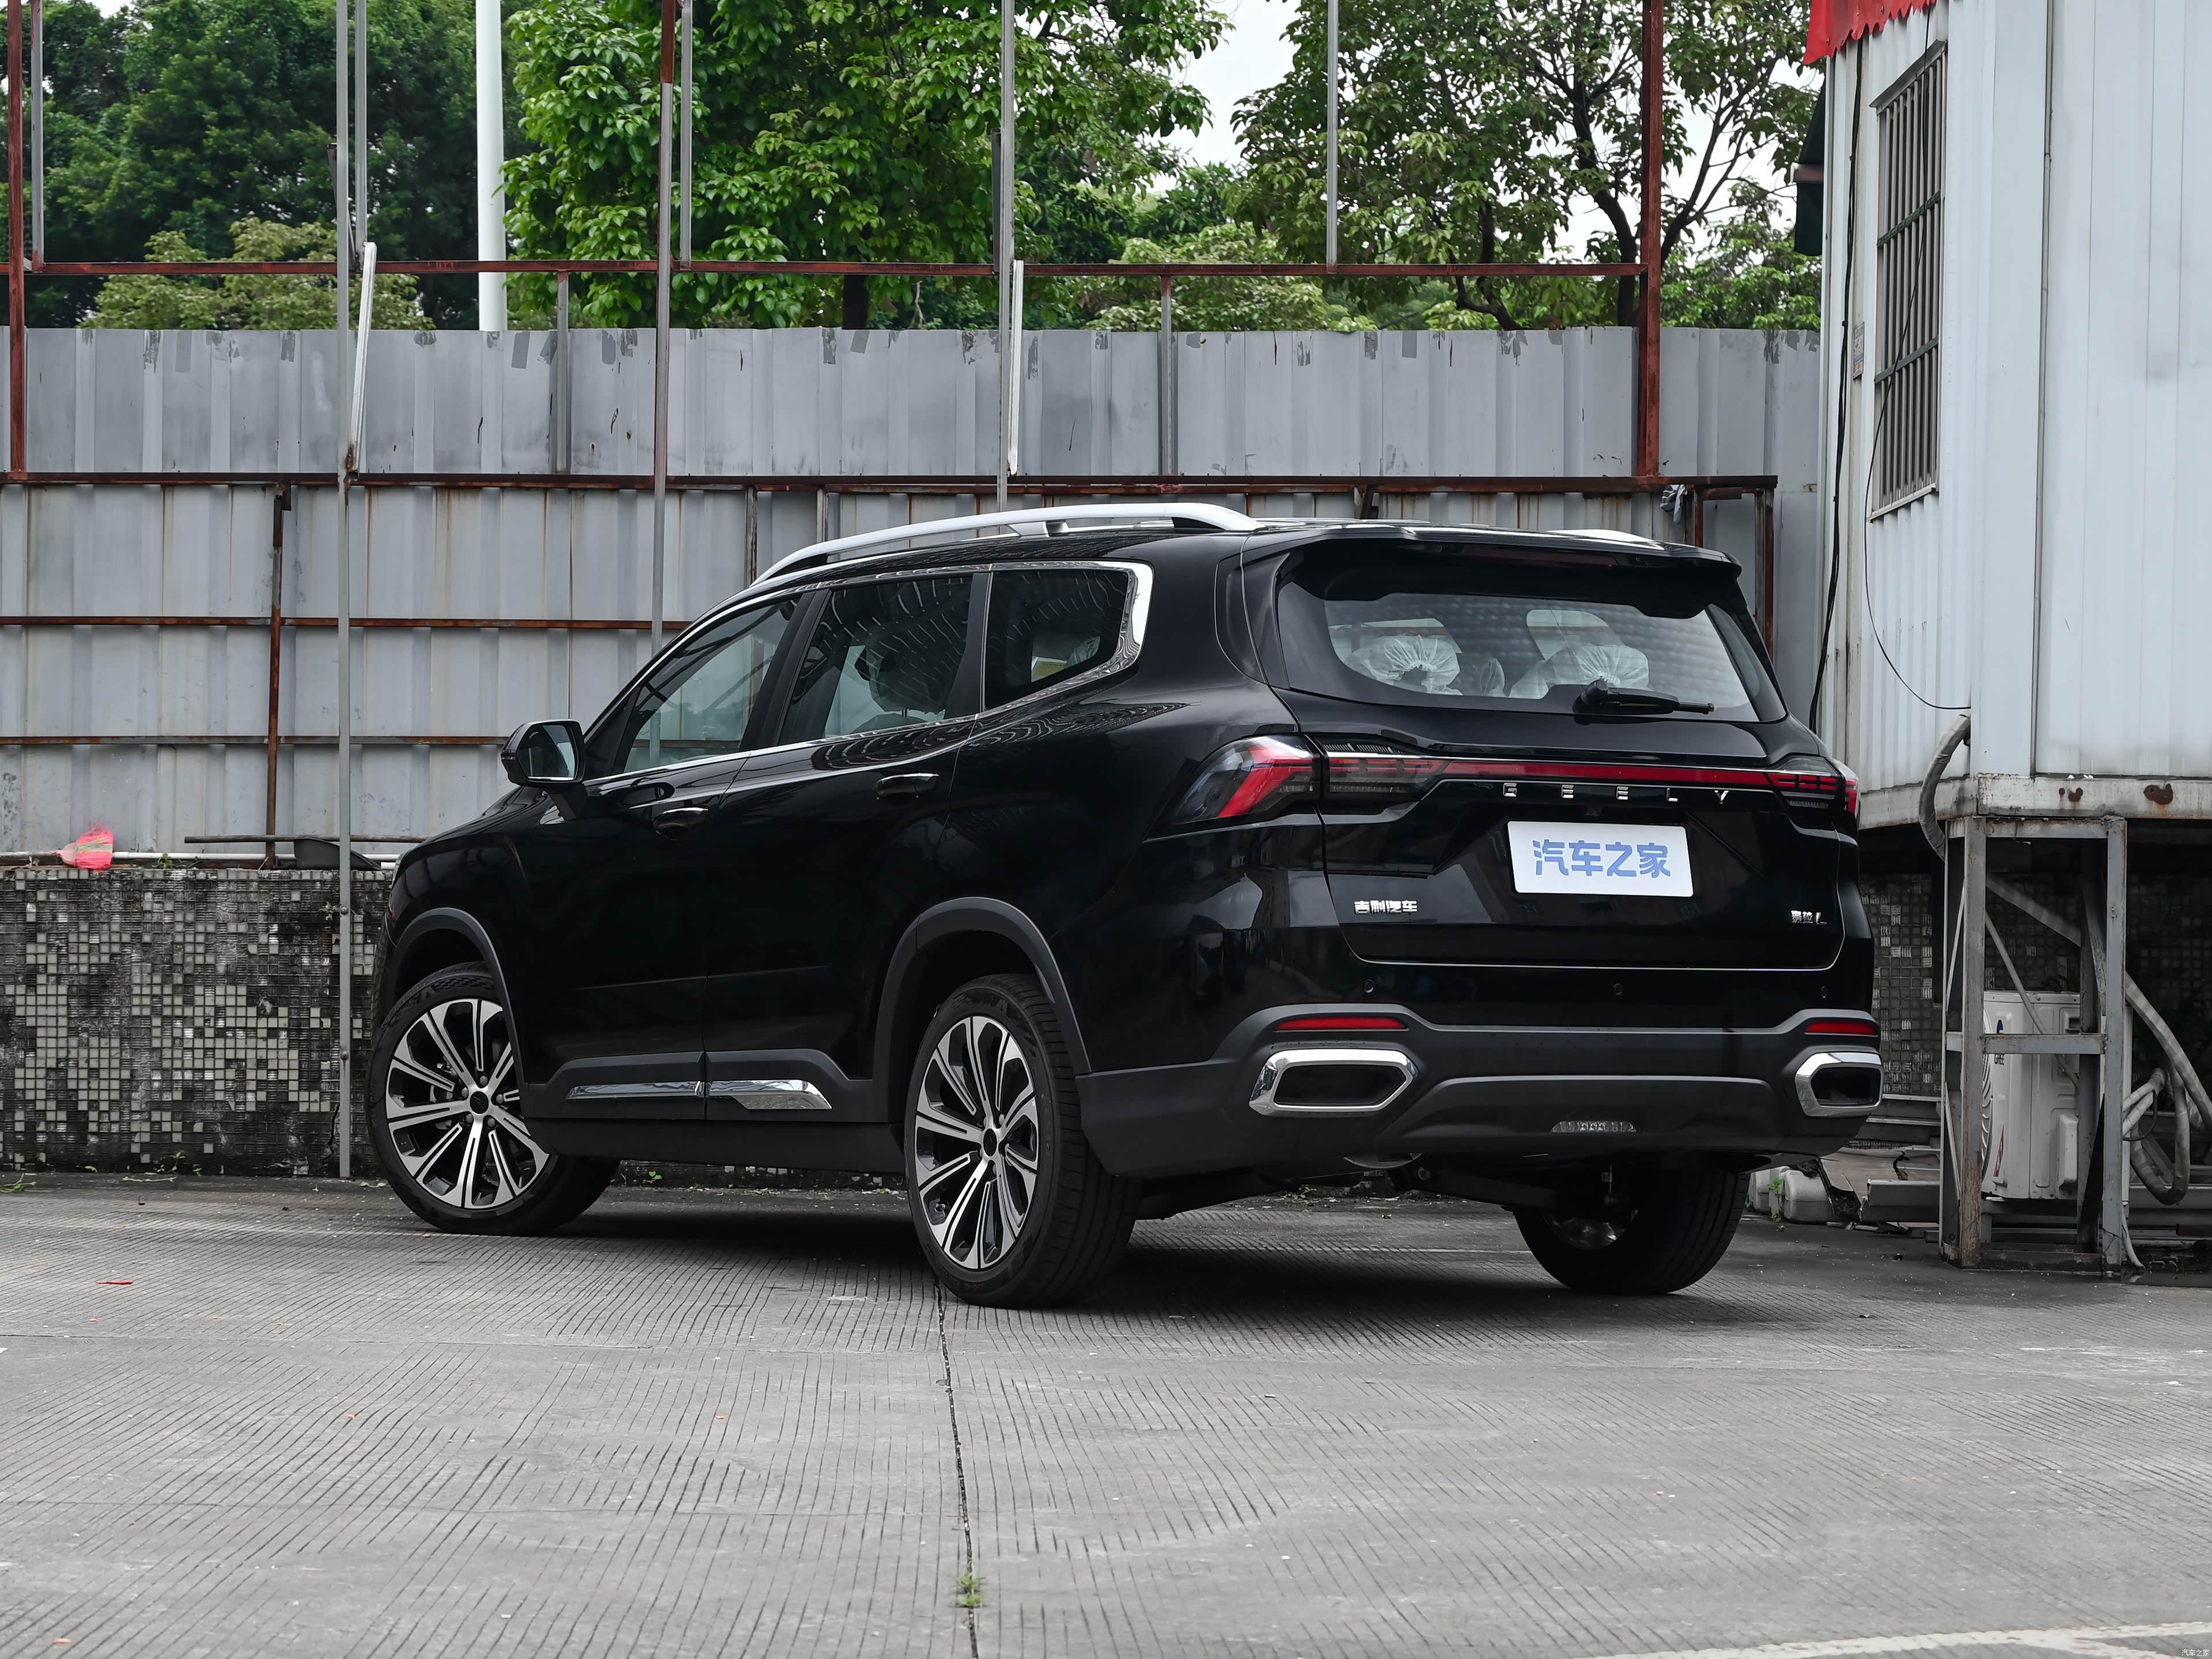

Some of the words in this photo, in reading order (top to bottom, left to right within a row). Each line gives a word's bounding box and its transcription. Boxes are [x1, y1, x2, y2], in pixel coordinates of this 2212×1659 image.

[1503, 783, 1729, 804] GEELY
[1532, 839, 1671, 878] 汽车之家
[1354, 900, 1418, 914] 吉利汽车
